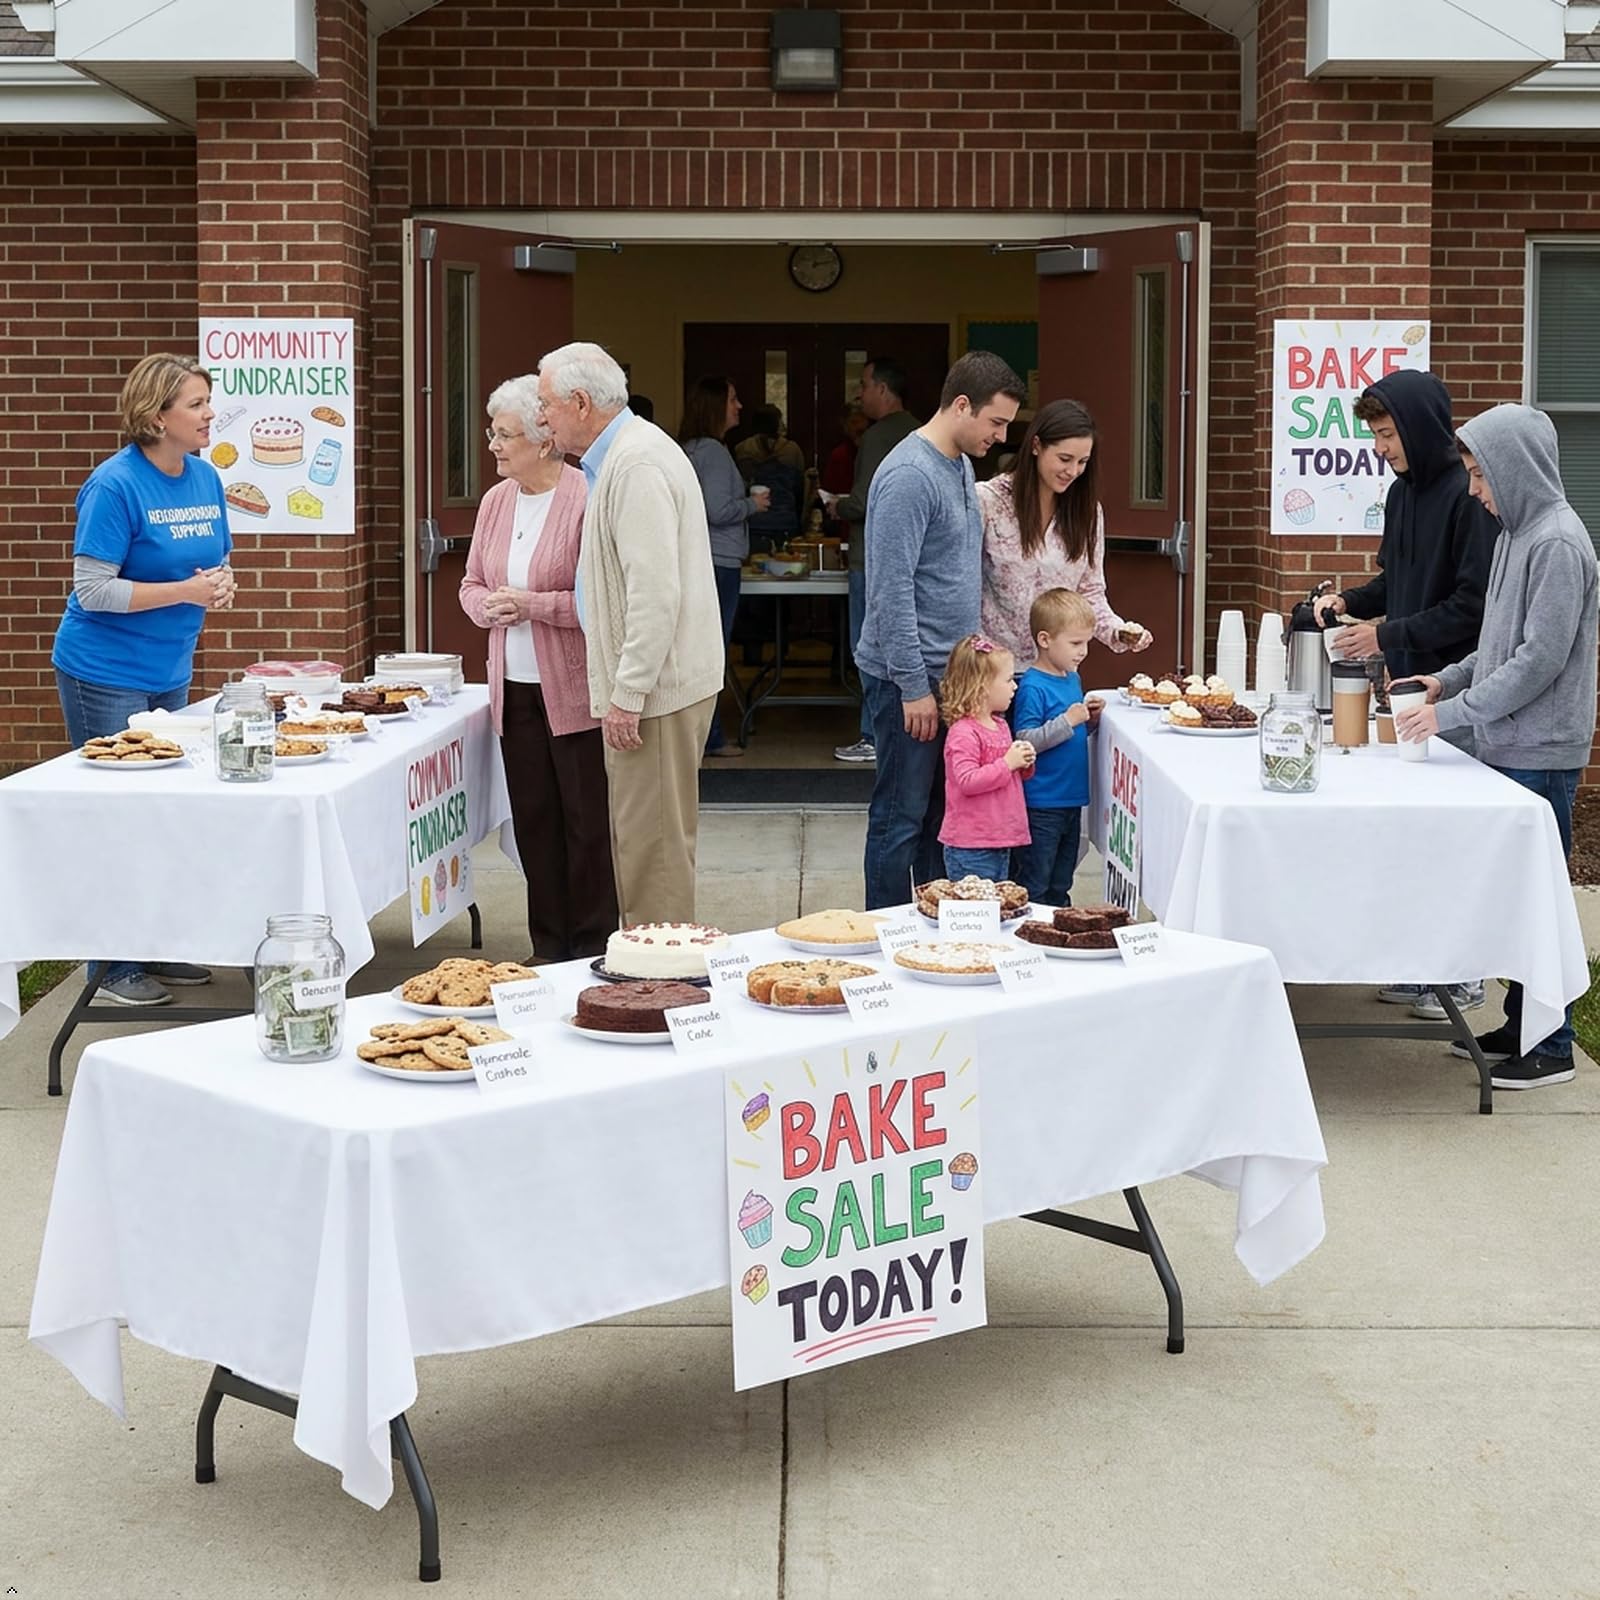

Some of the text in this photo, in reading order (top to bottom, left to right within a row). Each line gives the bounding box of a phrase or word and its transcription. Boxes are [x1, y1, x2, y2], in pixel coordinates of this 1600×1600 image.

[206, 330, 348, 360] COMMUNITY
[207, 366, 350, 396] FUNDRAISER
[1288, 396, 1376, 439] SAL
[1109, 802, 1136, 873] SALE
[780, 1071, 947, 1181] BAKE
[780, 1159, 945, 1269] SALE
[777, 1237, 969, 1343] TODAY!
